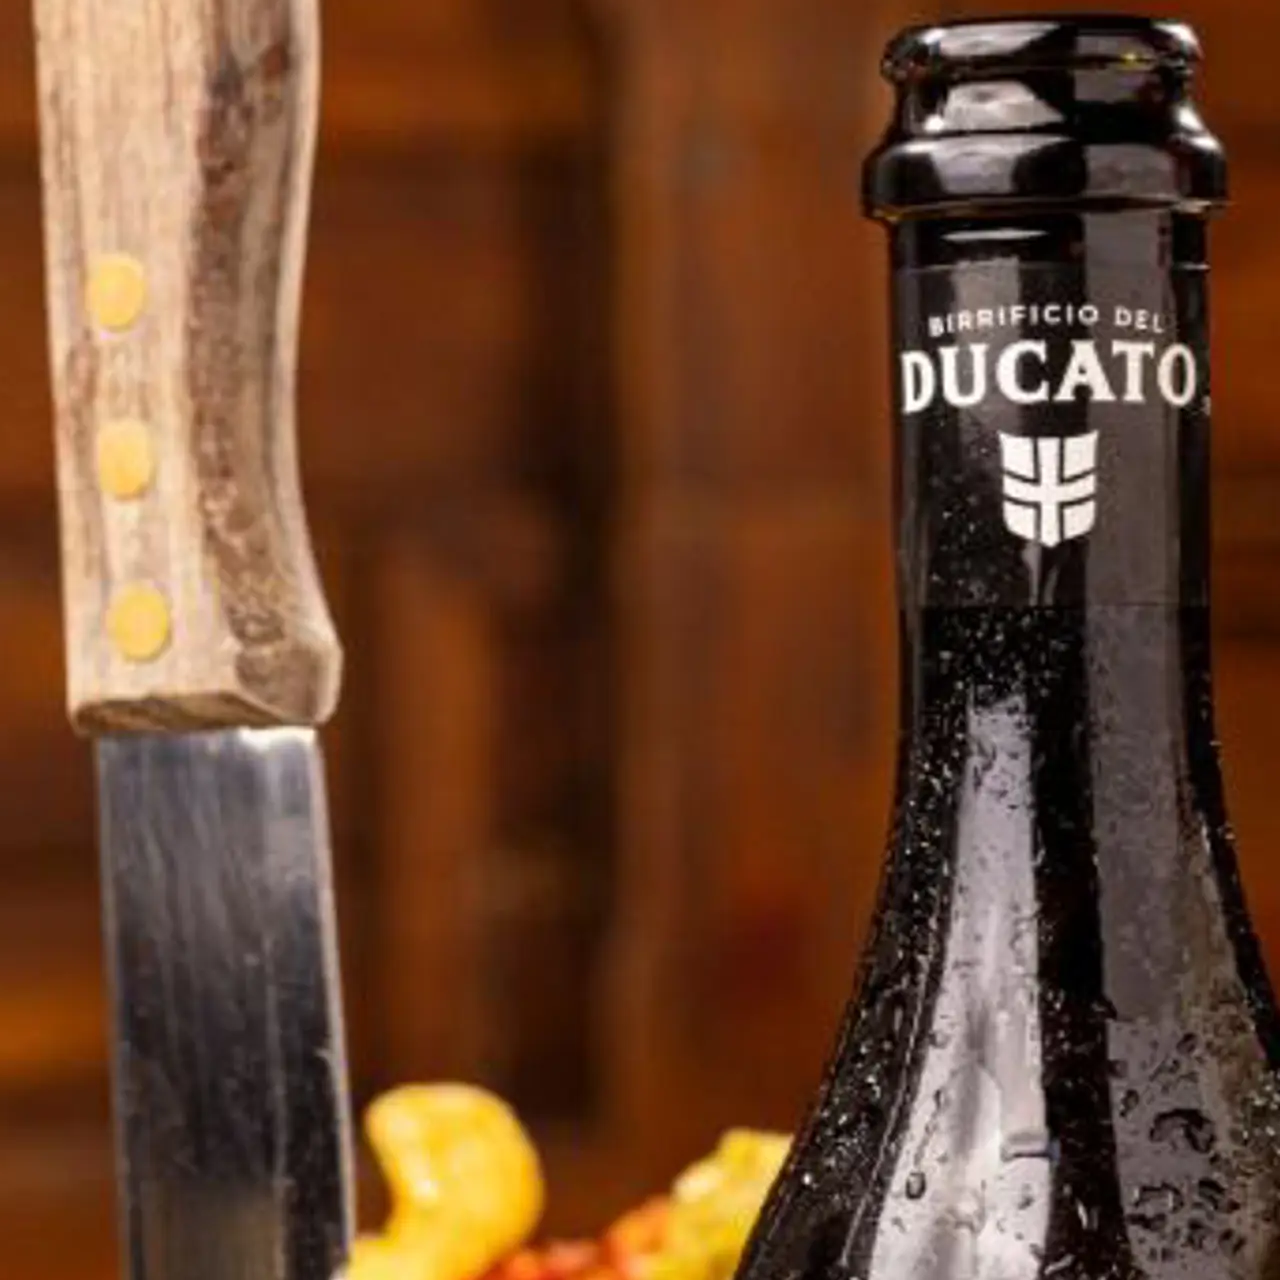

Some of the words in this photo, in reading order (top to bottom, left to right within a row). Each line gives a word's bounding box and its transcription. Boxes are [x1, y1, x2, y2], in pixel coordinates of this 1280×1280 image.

[928, 304, 1099, 337] BIRRIFICIO
[1114, 307, 1164, 334] DEL
[900, 339, 1198, 415] DUCATO
